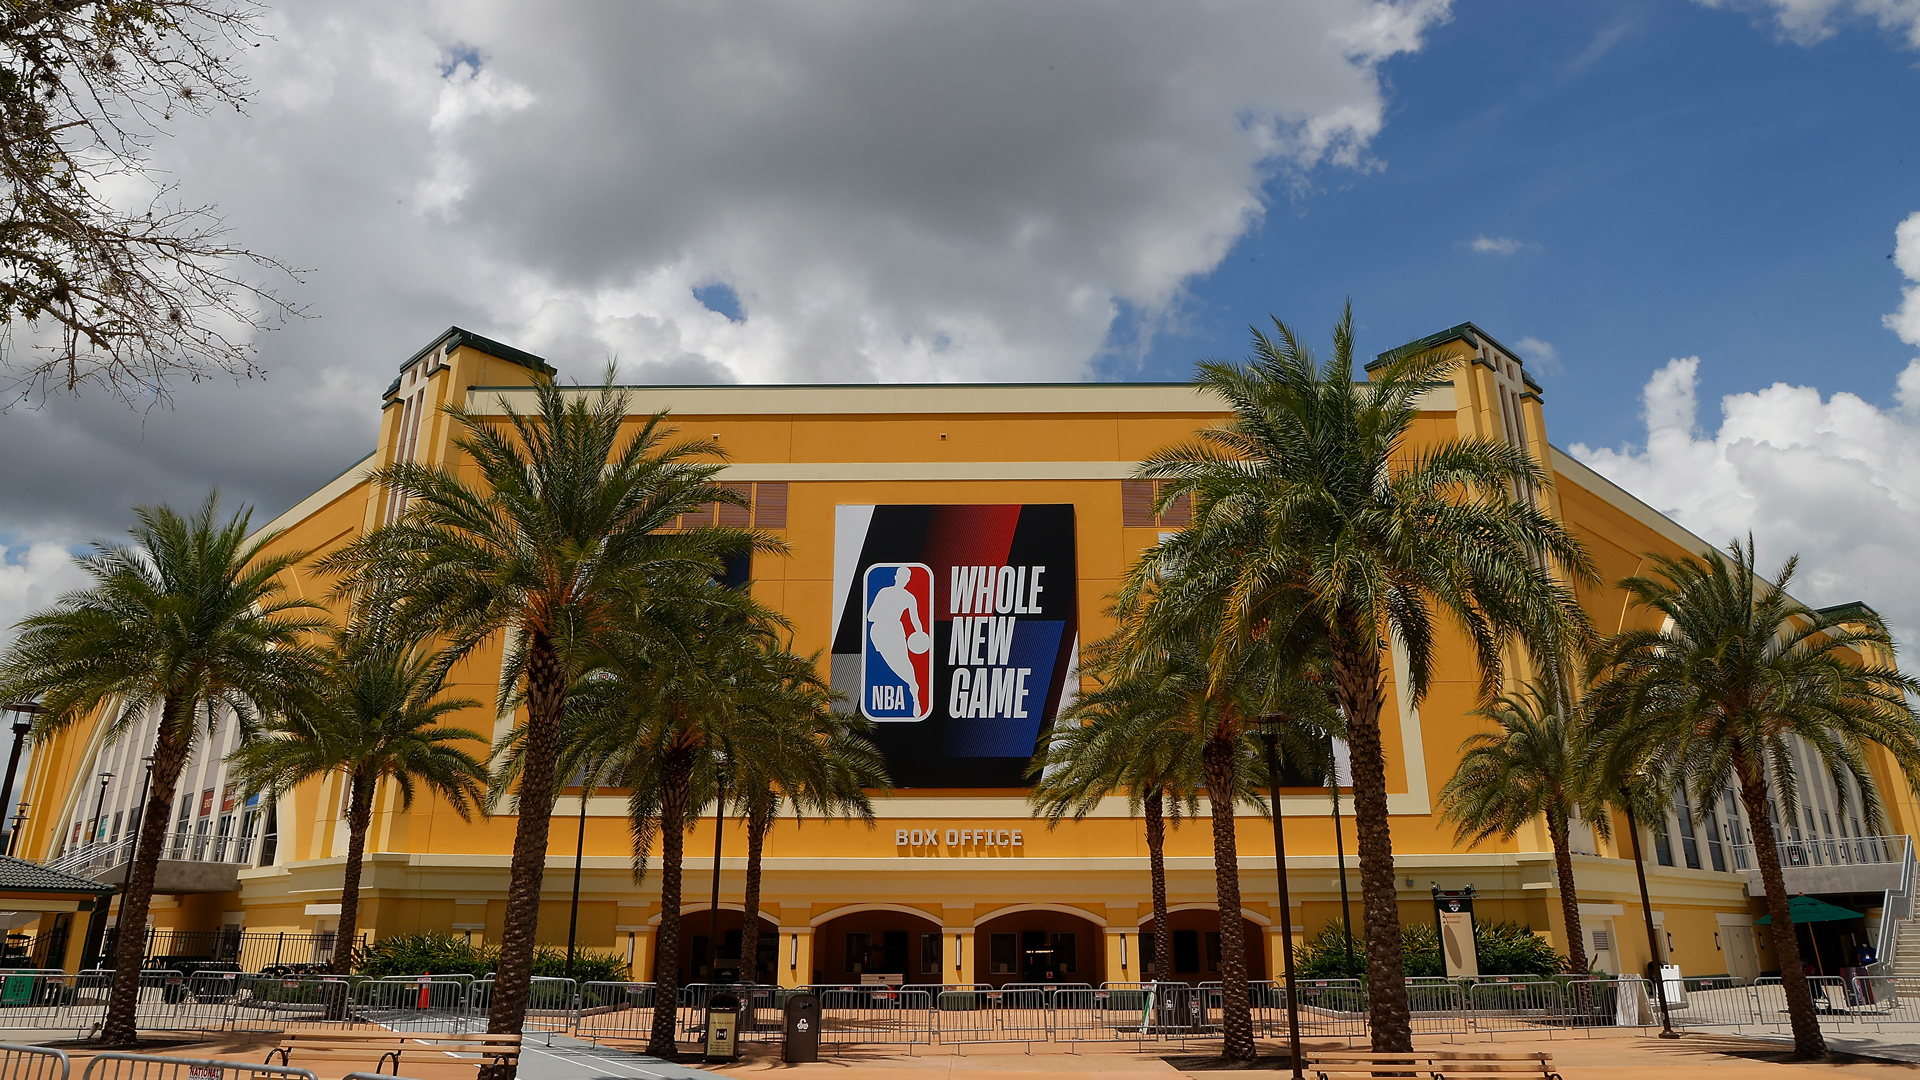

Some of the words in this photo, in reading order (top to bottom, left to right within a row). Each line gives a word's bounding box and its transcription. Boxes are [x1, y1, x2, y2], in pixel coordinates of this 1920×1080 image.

[950, 566, 1046, 614] WHOLE
[948, 616, 1016, 665] NEW
[872, 685, 905, 710] NBA
[949, 668, 1031, 719] GAME
[895, 829, 938, 846] BOX
[945, 829, 1022, 846] OFFICE
[189, 1067, 219, 1078] NATIONAL
